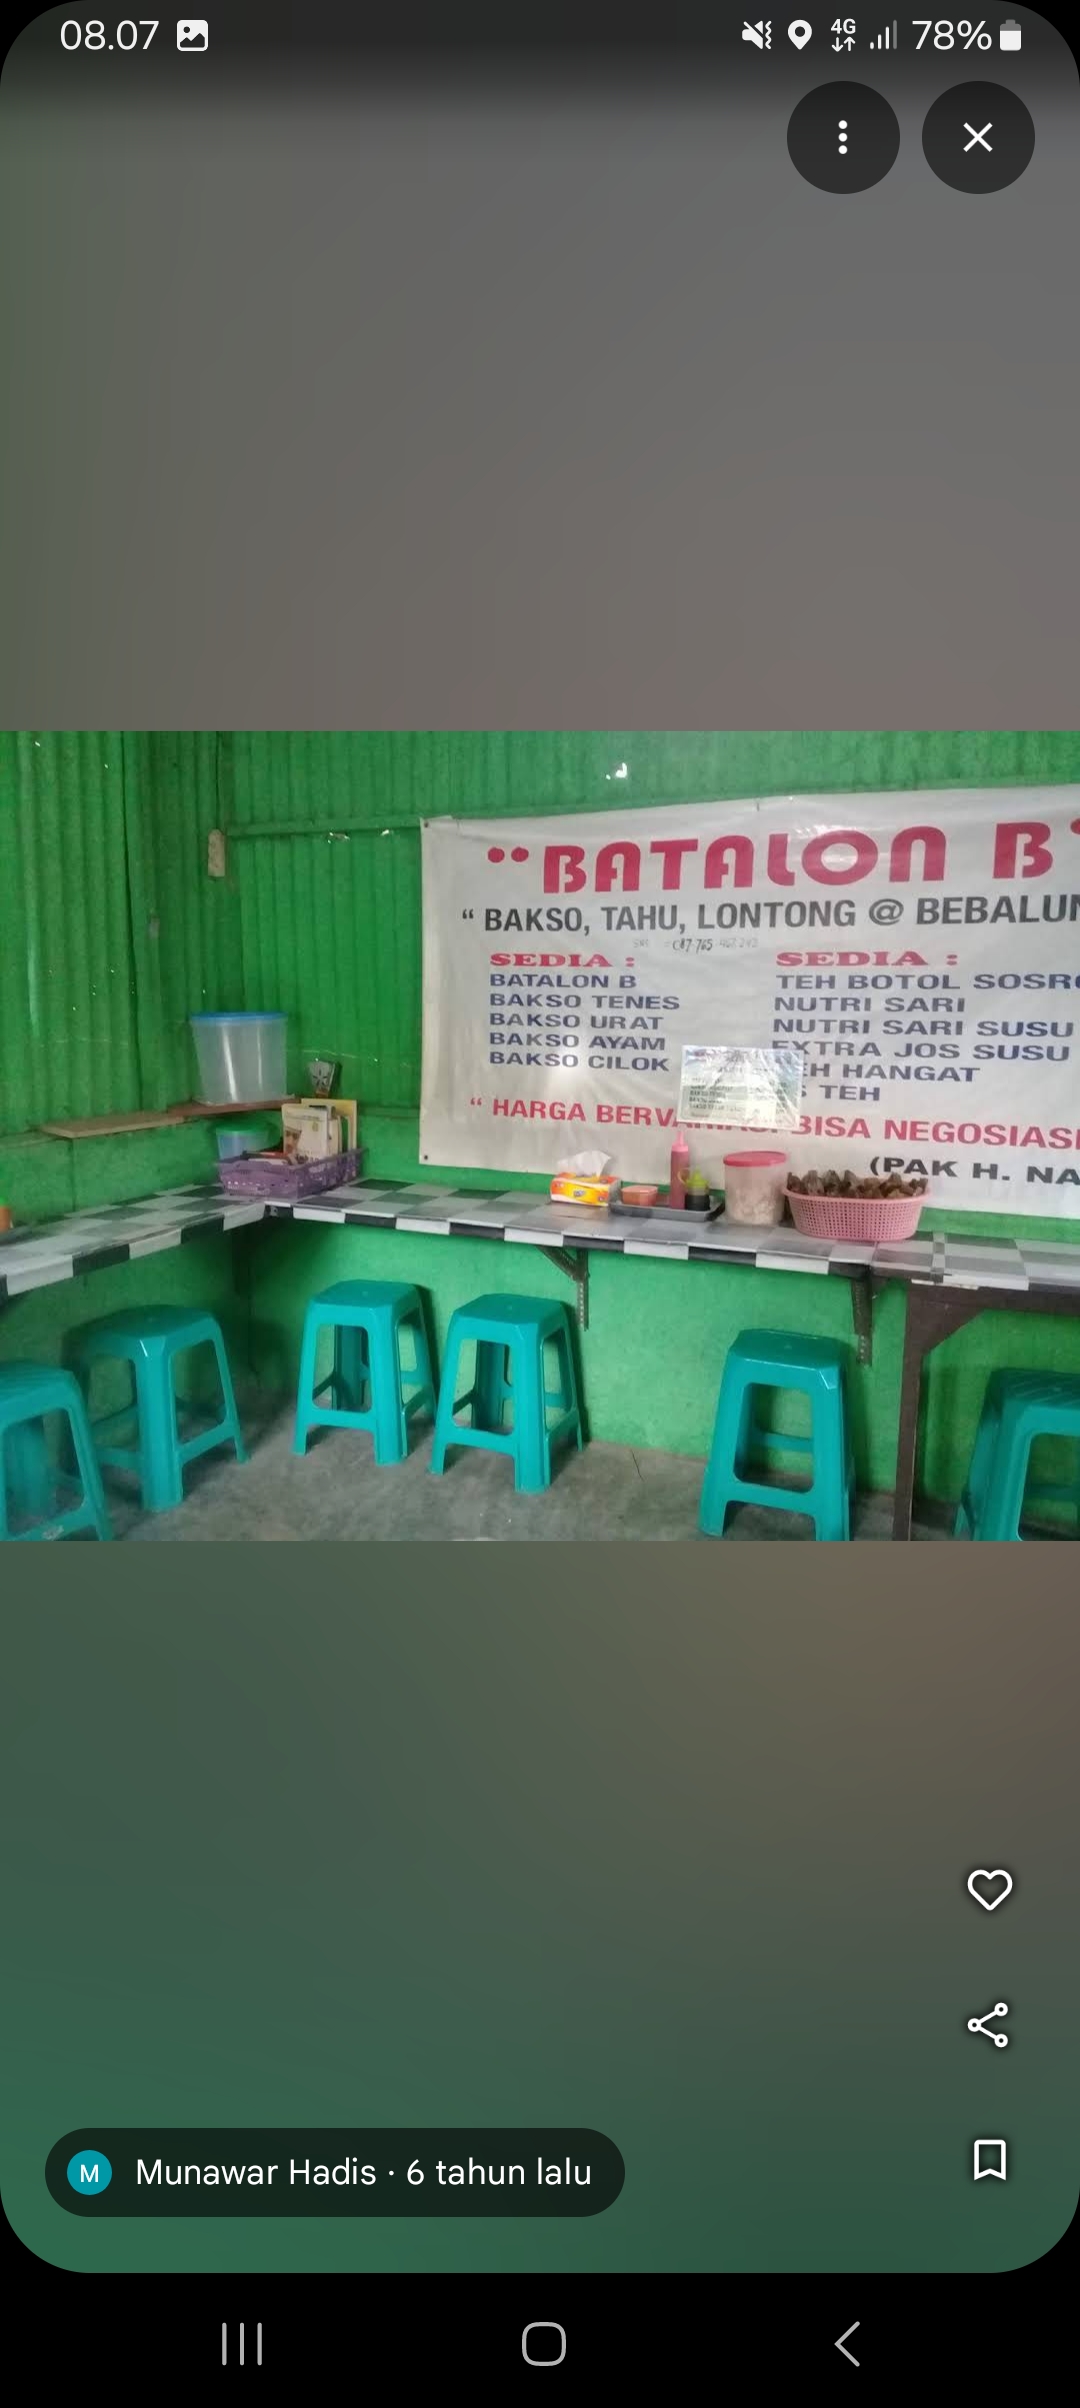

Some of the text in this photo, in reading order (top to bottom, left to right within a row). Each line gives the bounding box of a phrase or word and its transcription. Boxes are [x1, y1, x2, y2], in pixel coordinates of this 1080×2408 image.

[485, 908, 590, 936] BAKSO,
[601, 904, 686, 934] TAHU,
[698, 900, 856, 929] LONTONG
[868, 898, 904, 926] @
[489, 953, 613, 968] SEDIA
[776, 951, 929, 967] SEDIA
[489, 973, 637, 989] BATALON B
[776, 973, 1080, 990] TEH BOTOL SOSR
[489, 993, 681, 1010] BAKSO TENES
[774, 997, 966, 1013] NUTRI SARI
[489, 1012, 664, 1031] BAKSO URAT
[772, 1018, 1074, 1038] NUTRI SARI SUSU
[489, 1032, 666, 1051] BAKSO AYAM
[488, 1051, 670, 1072] BAKSO CILOK
[894, 1043, 961, 1059] JOS
[972, 1044, 1071, 1062] SUSU
[842, 1064, 981, 1082] HANGAT
[819, 1085, 881, 1101] TEH
[492, 1098, 586, 1122] HARGA
[869, 1156, 959, 1178] (PAK
[971, 1163, 1011, 1182] H.
